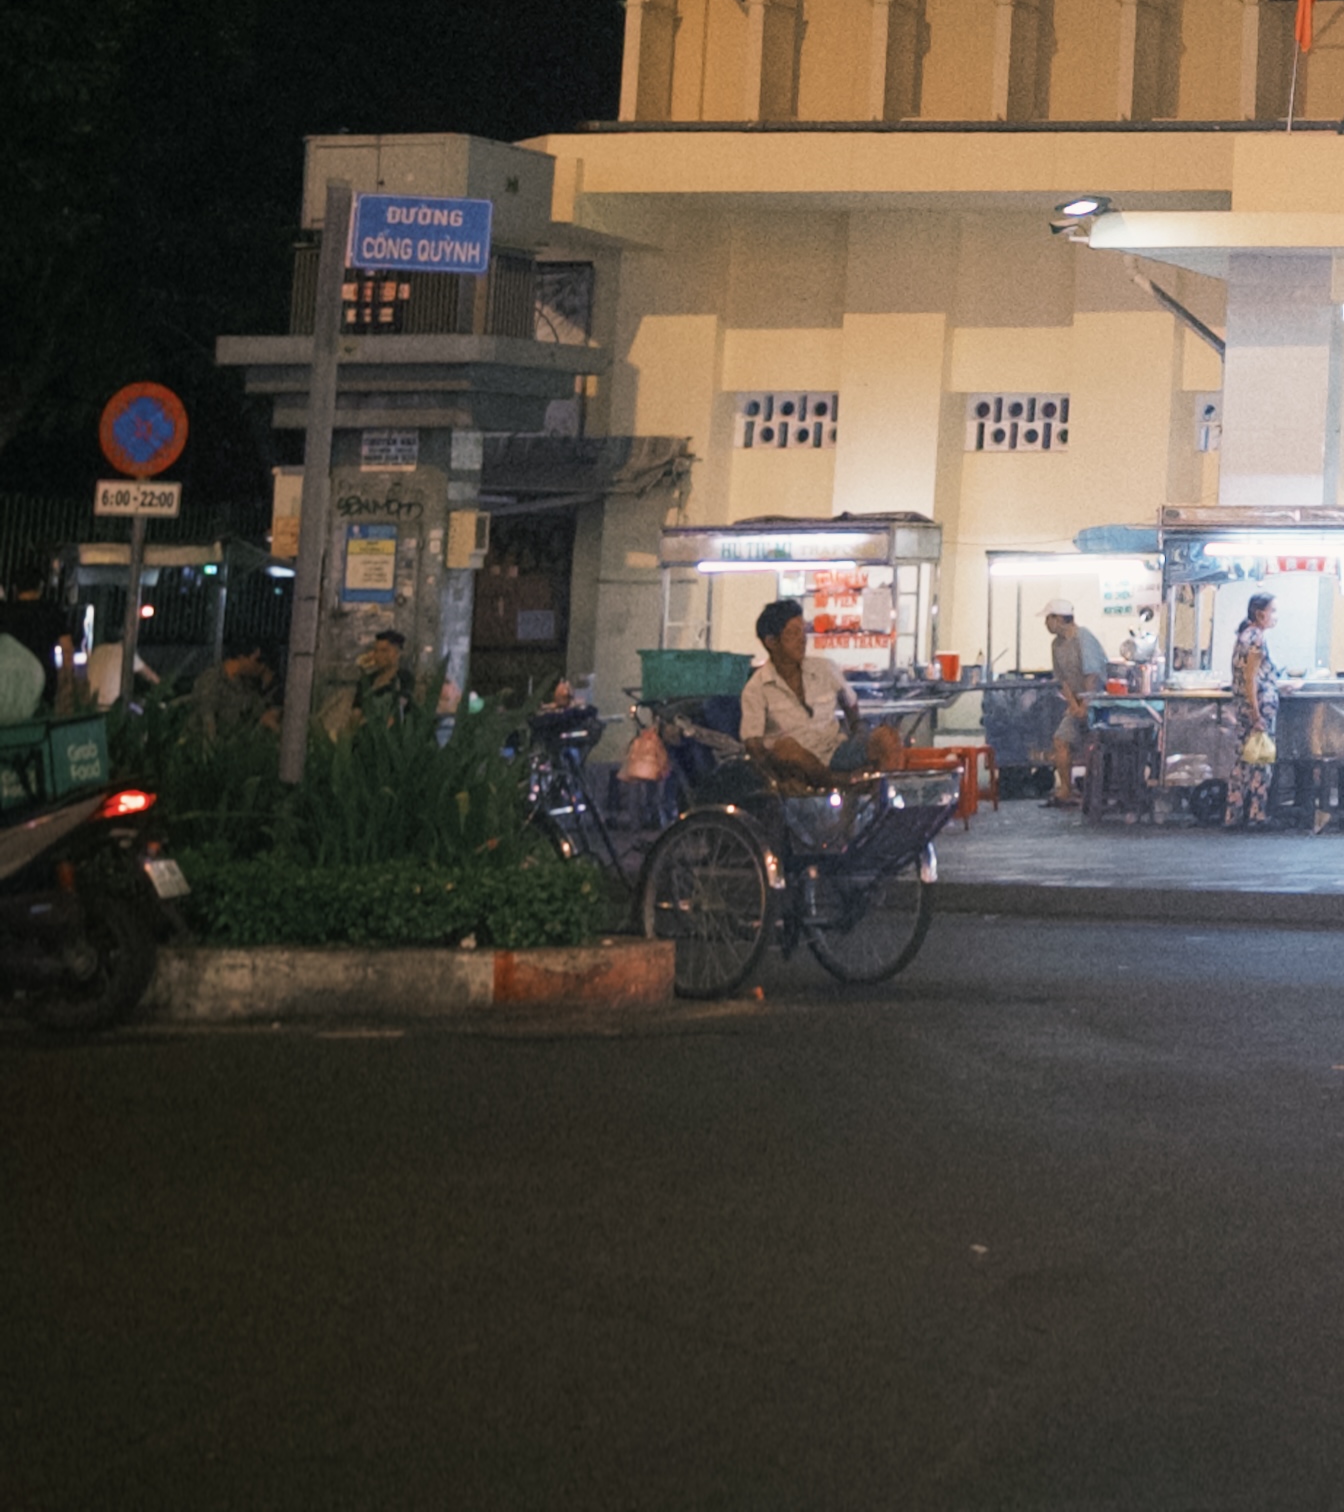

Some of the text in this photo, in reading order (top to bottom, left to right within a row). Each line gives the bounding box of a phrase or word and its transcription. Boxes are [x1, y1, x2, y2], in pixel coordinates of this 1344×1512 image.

[386, 203, 464, 227] ĐƯỜNG
[362, 229, 481, 264] CỐNG QUỲNH
[67, 739, 99, 763] Grab
[69, 760, 101, 782] Food
